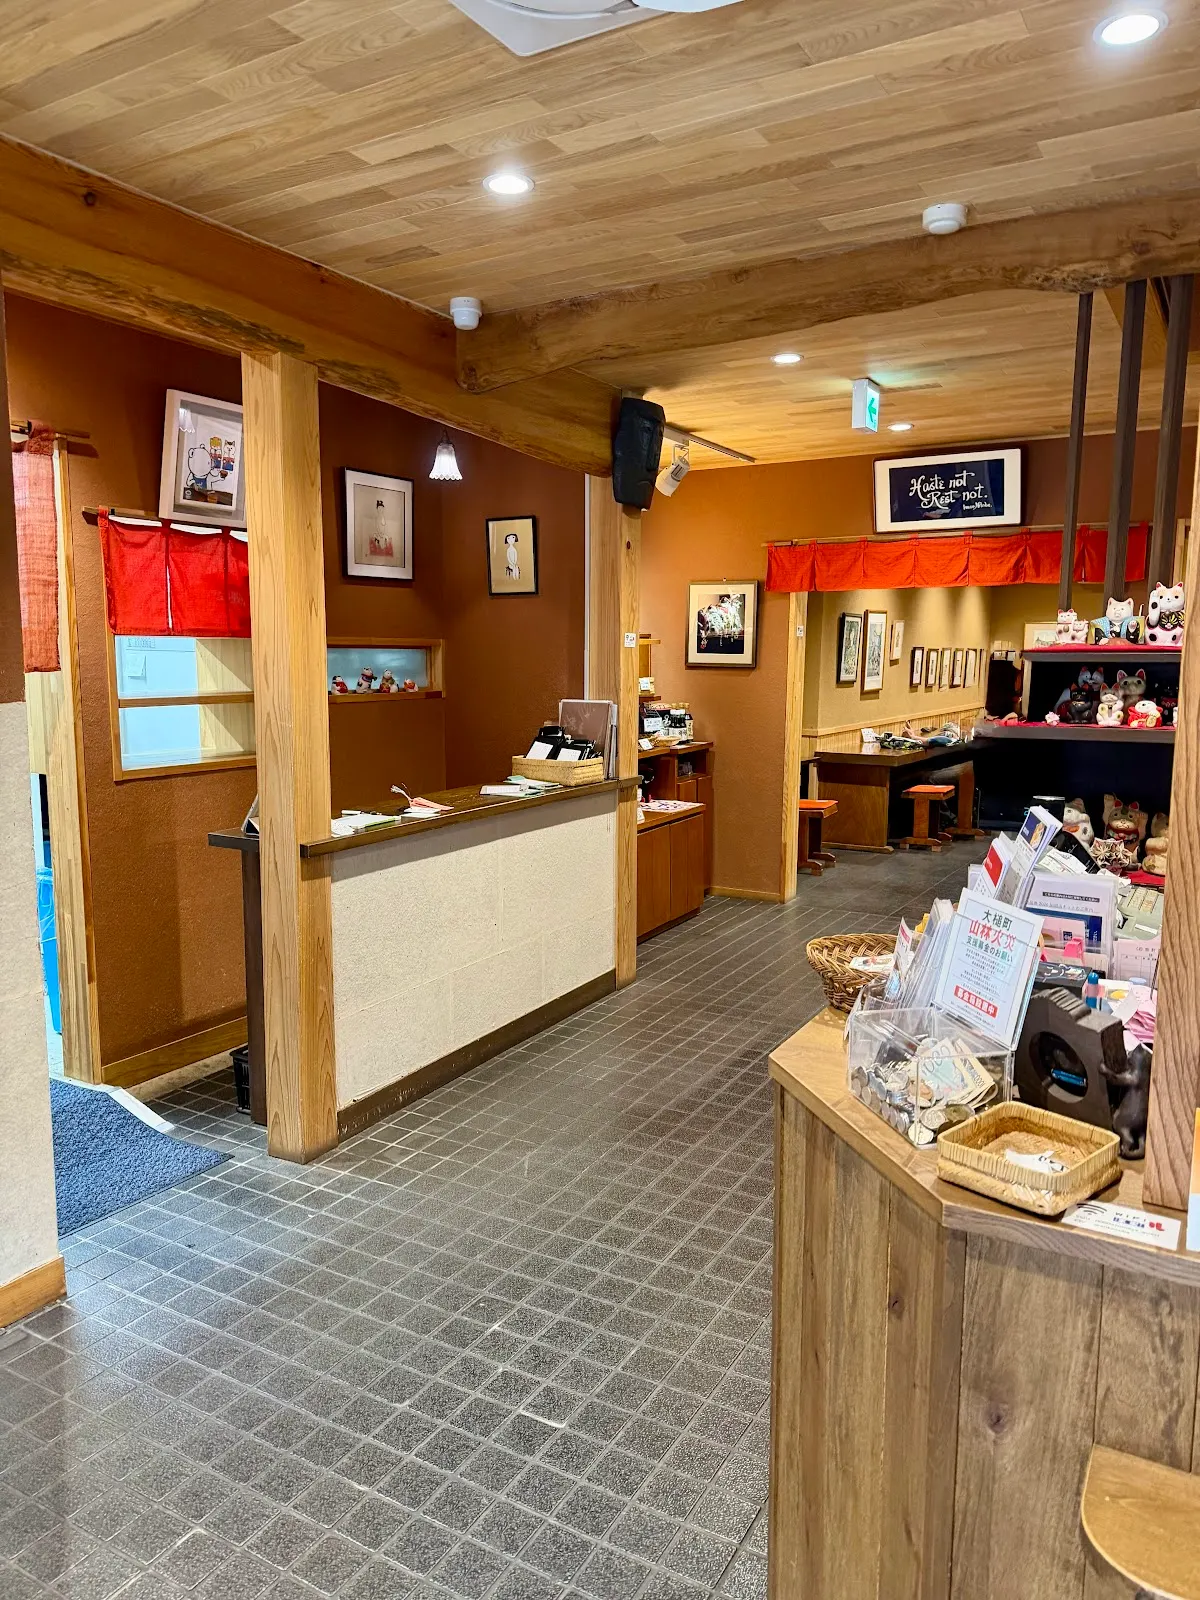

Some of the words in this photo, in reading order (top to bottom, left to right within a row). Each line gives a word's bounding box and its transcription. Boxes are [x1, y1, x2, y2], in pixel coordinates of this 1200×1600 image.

[909, 474, 946, 502] Haste
[949, 470, 976, 489] not
[920, 490, 959, 510] Rest
[962, 483, 988, 502] not.
[982, 909, 1013, 931] 大槌町
[968, 919, 1017, 952] 山林火災
